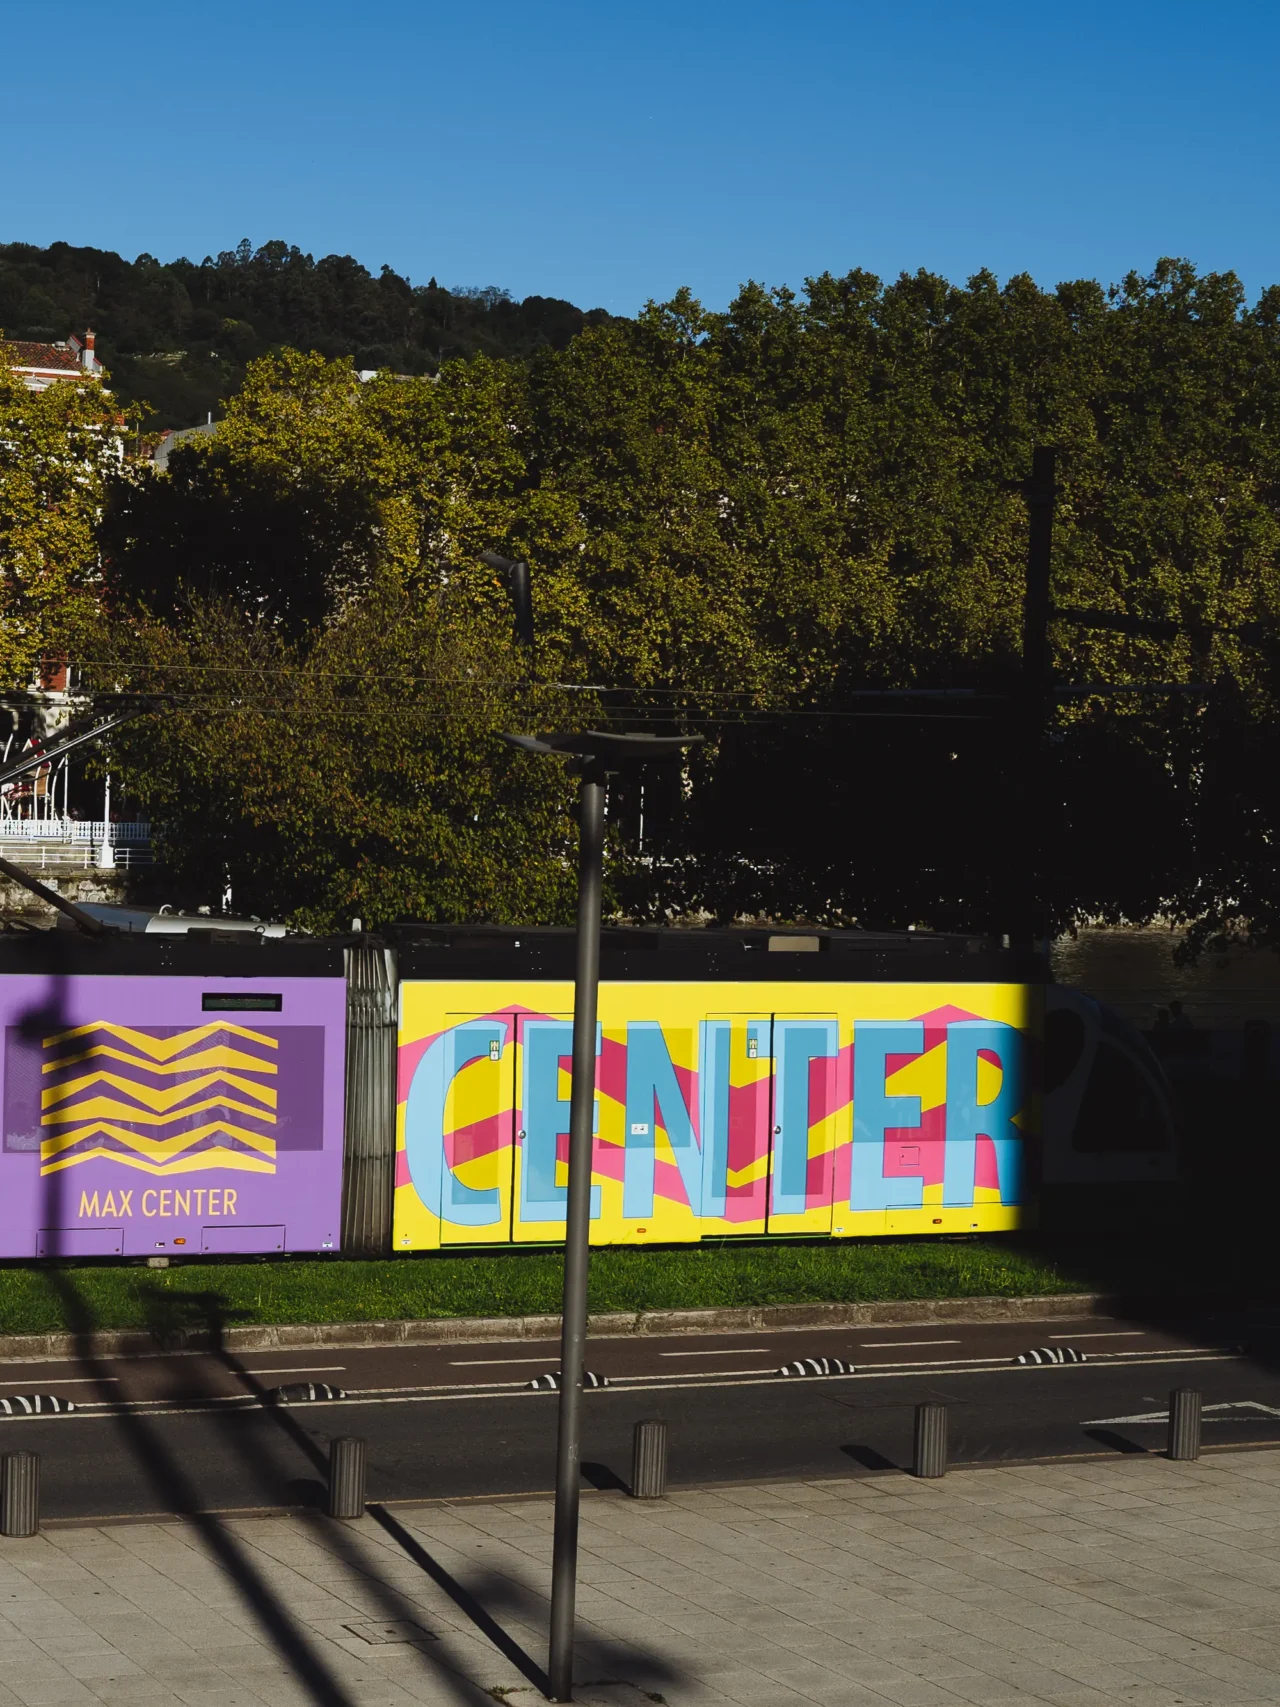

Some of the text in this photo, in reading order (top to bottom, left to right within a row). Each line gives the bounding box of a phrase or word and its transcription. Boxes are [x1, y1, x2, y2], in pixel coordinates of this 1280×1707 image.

[404, 1018, 1031, 1228] CENTER
[78, 1188, 238, 1218] MAX CENTER
